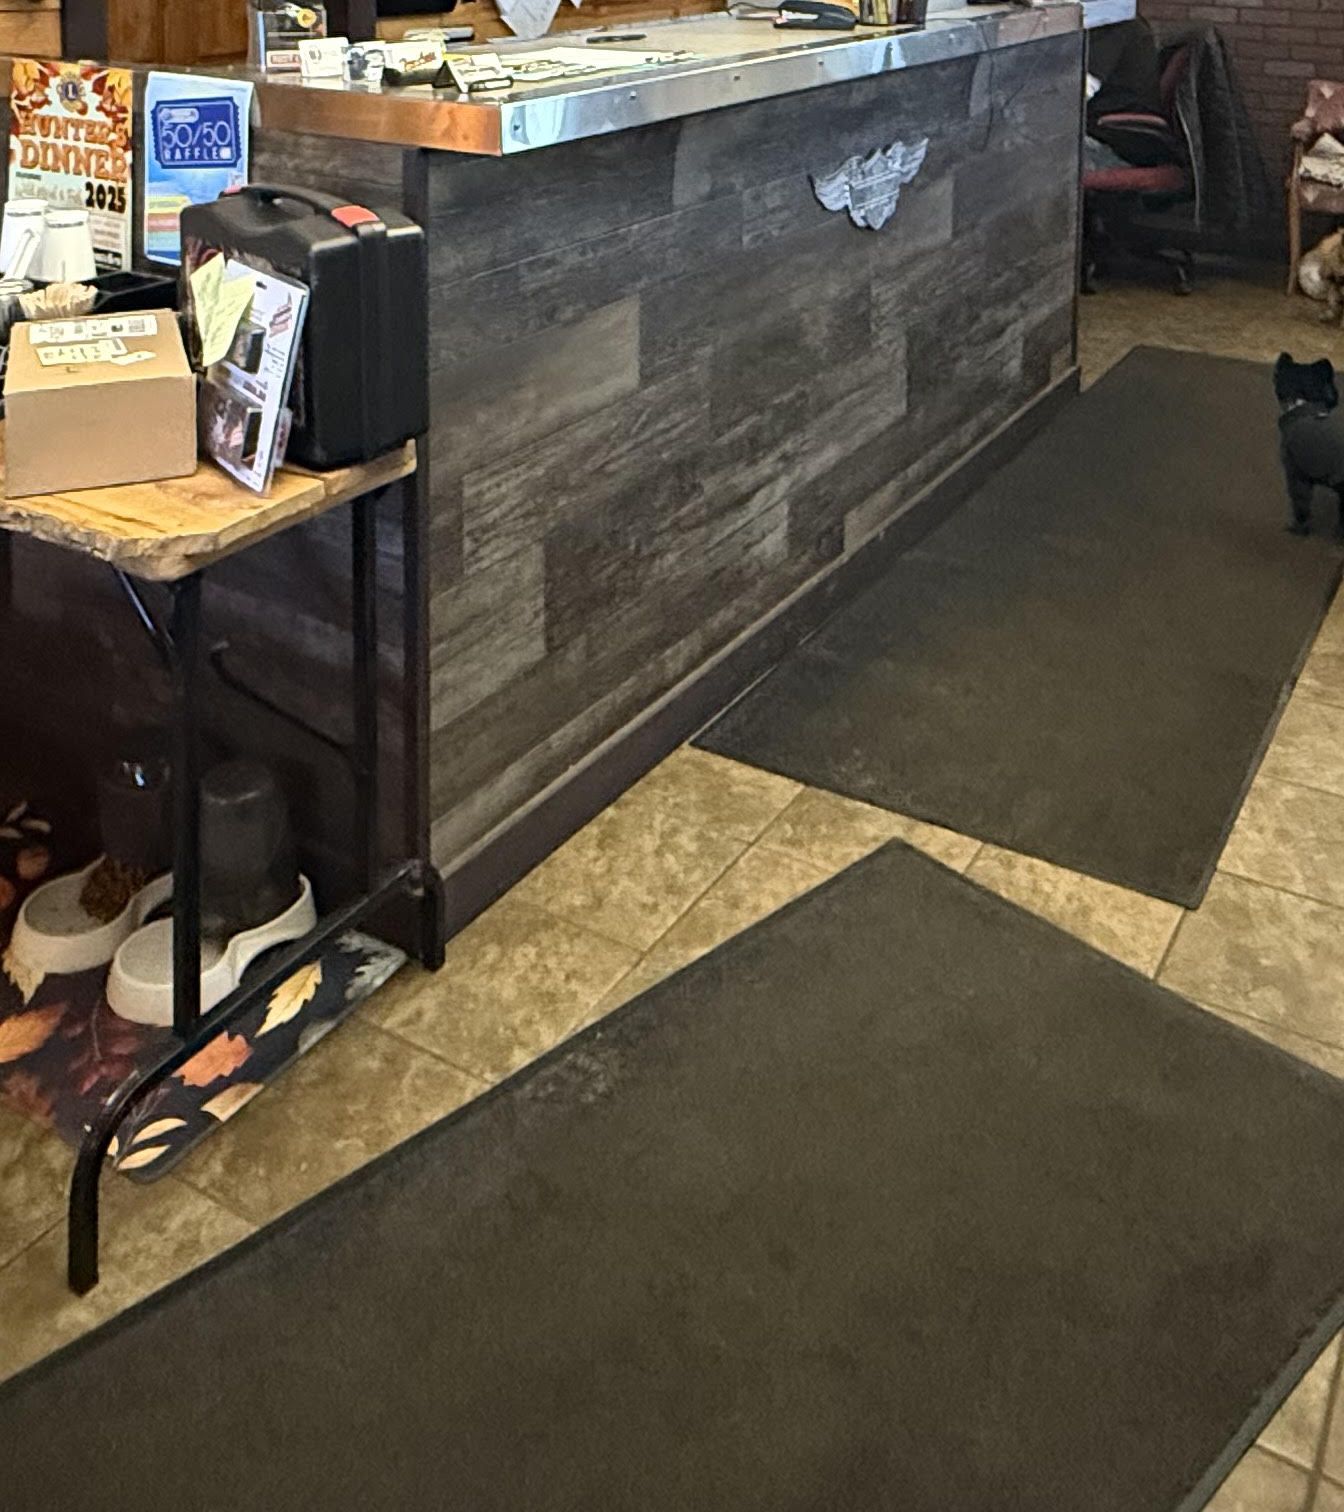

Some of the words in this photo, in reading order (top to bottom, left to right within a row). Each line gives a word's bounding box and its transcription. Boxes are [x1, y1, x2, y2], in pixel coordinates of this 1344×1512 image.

[160, 120, 232, 149] 50/50
[19, 138, 129, 183] DINNER
[163, 146, 219, 161] RAFFLE
[85, 181, 127, 214] 2025
